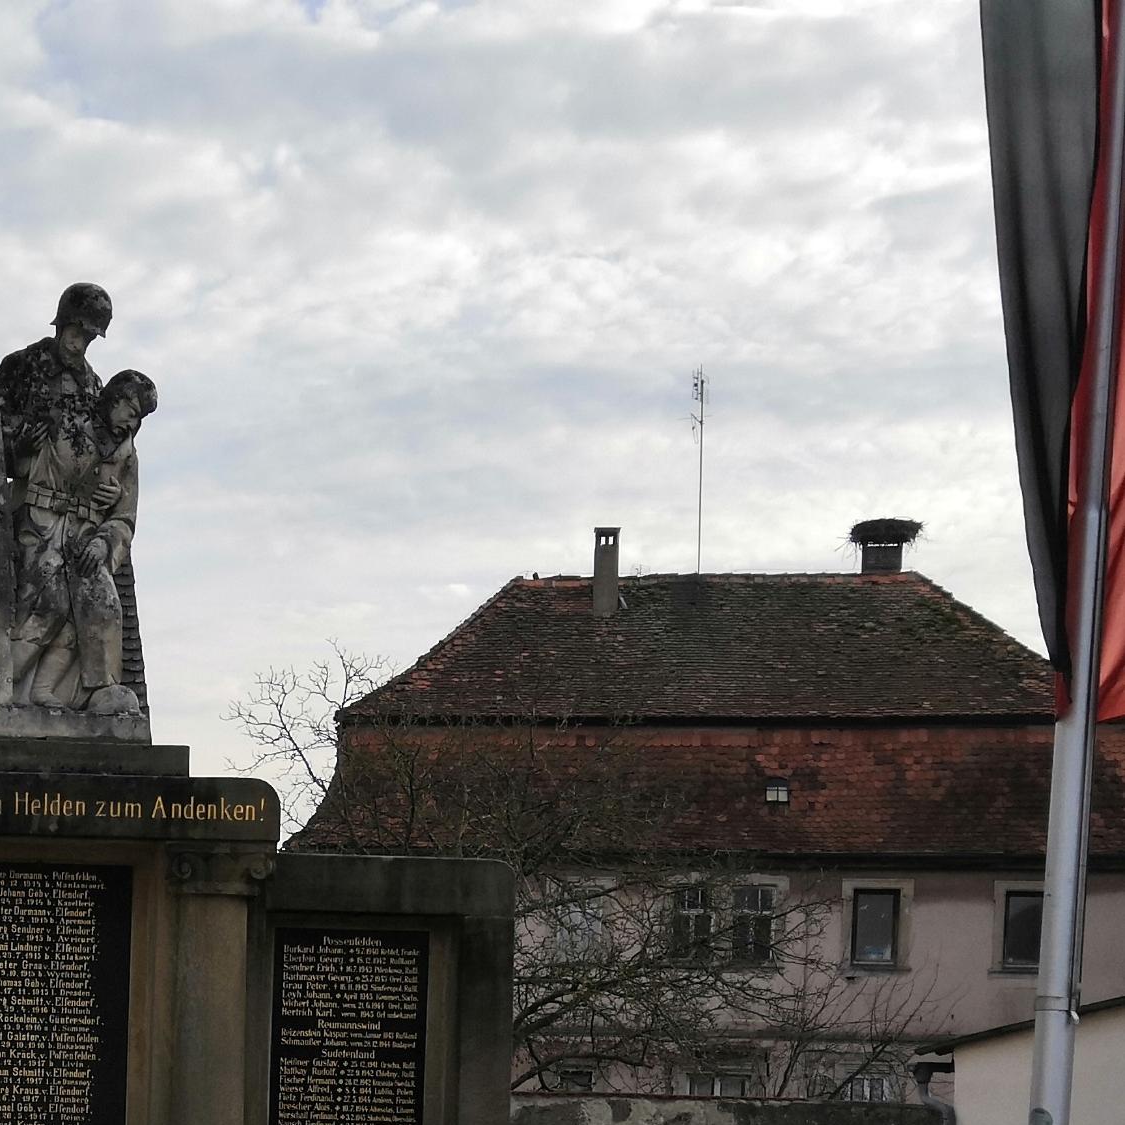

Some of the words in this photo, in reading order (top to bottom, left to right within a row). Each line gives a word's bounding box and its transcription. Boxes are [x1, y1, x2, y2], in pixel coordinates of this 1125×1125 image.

[14, 792, 86, 817] Helden
[95, 800, 142, 818] zum
[151, 798, 265, 822] Andenken!
[323, 936, 382, 946] Possenfelden
[283, 981, 302, 990] Grau
[318, 1019, 380, 1030] Reumannswind
[321, 1049, 375, 1059] Sudetenland
